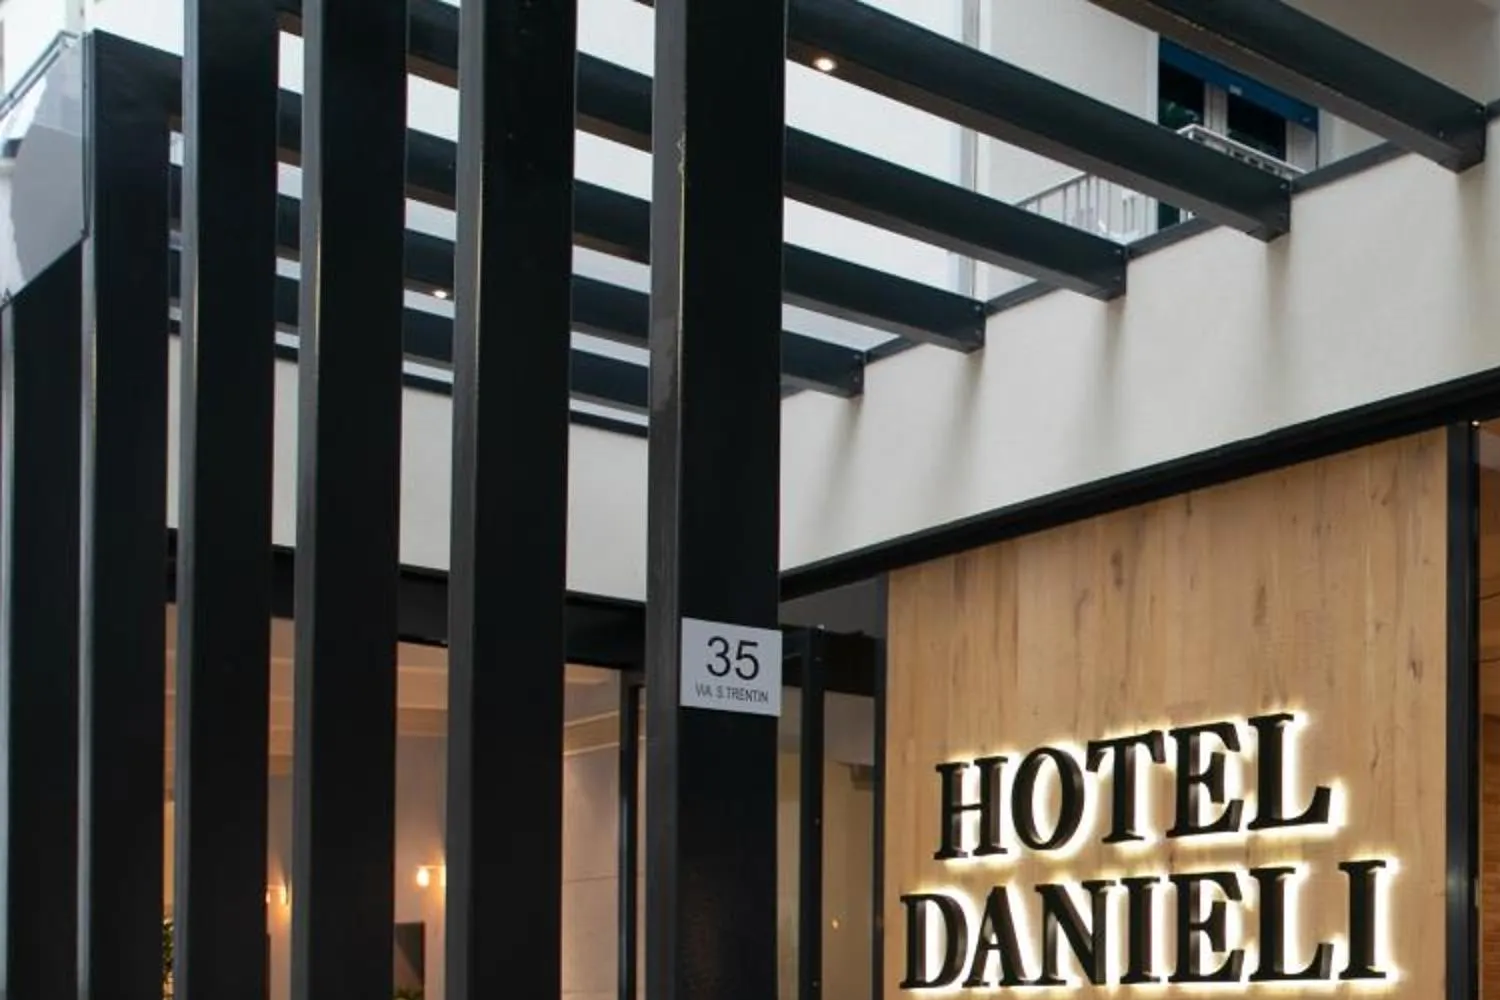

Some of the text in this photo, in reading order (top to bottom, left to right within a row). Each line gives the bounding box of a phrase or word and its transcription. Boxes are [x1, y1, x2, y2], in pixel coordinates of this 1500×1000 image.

[695, 681, 713, 698] VIA
[706, 635, 760, 681] 35
[933, 712, 1332, 861] HOTEL
[899, 858, 1388, 990] DANIELI
